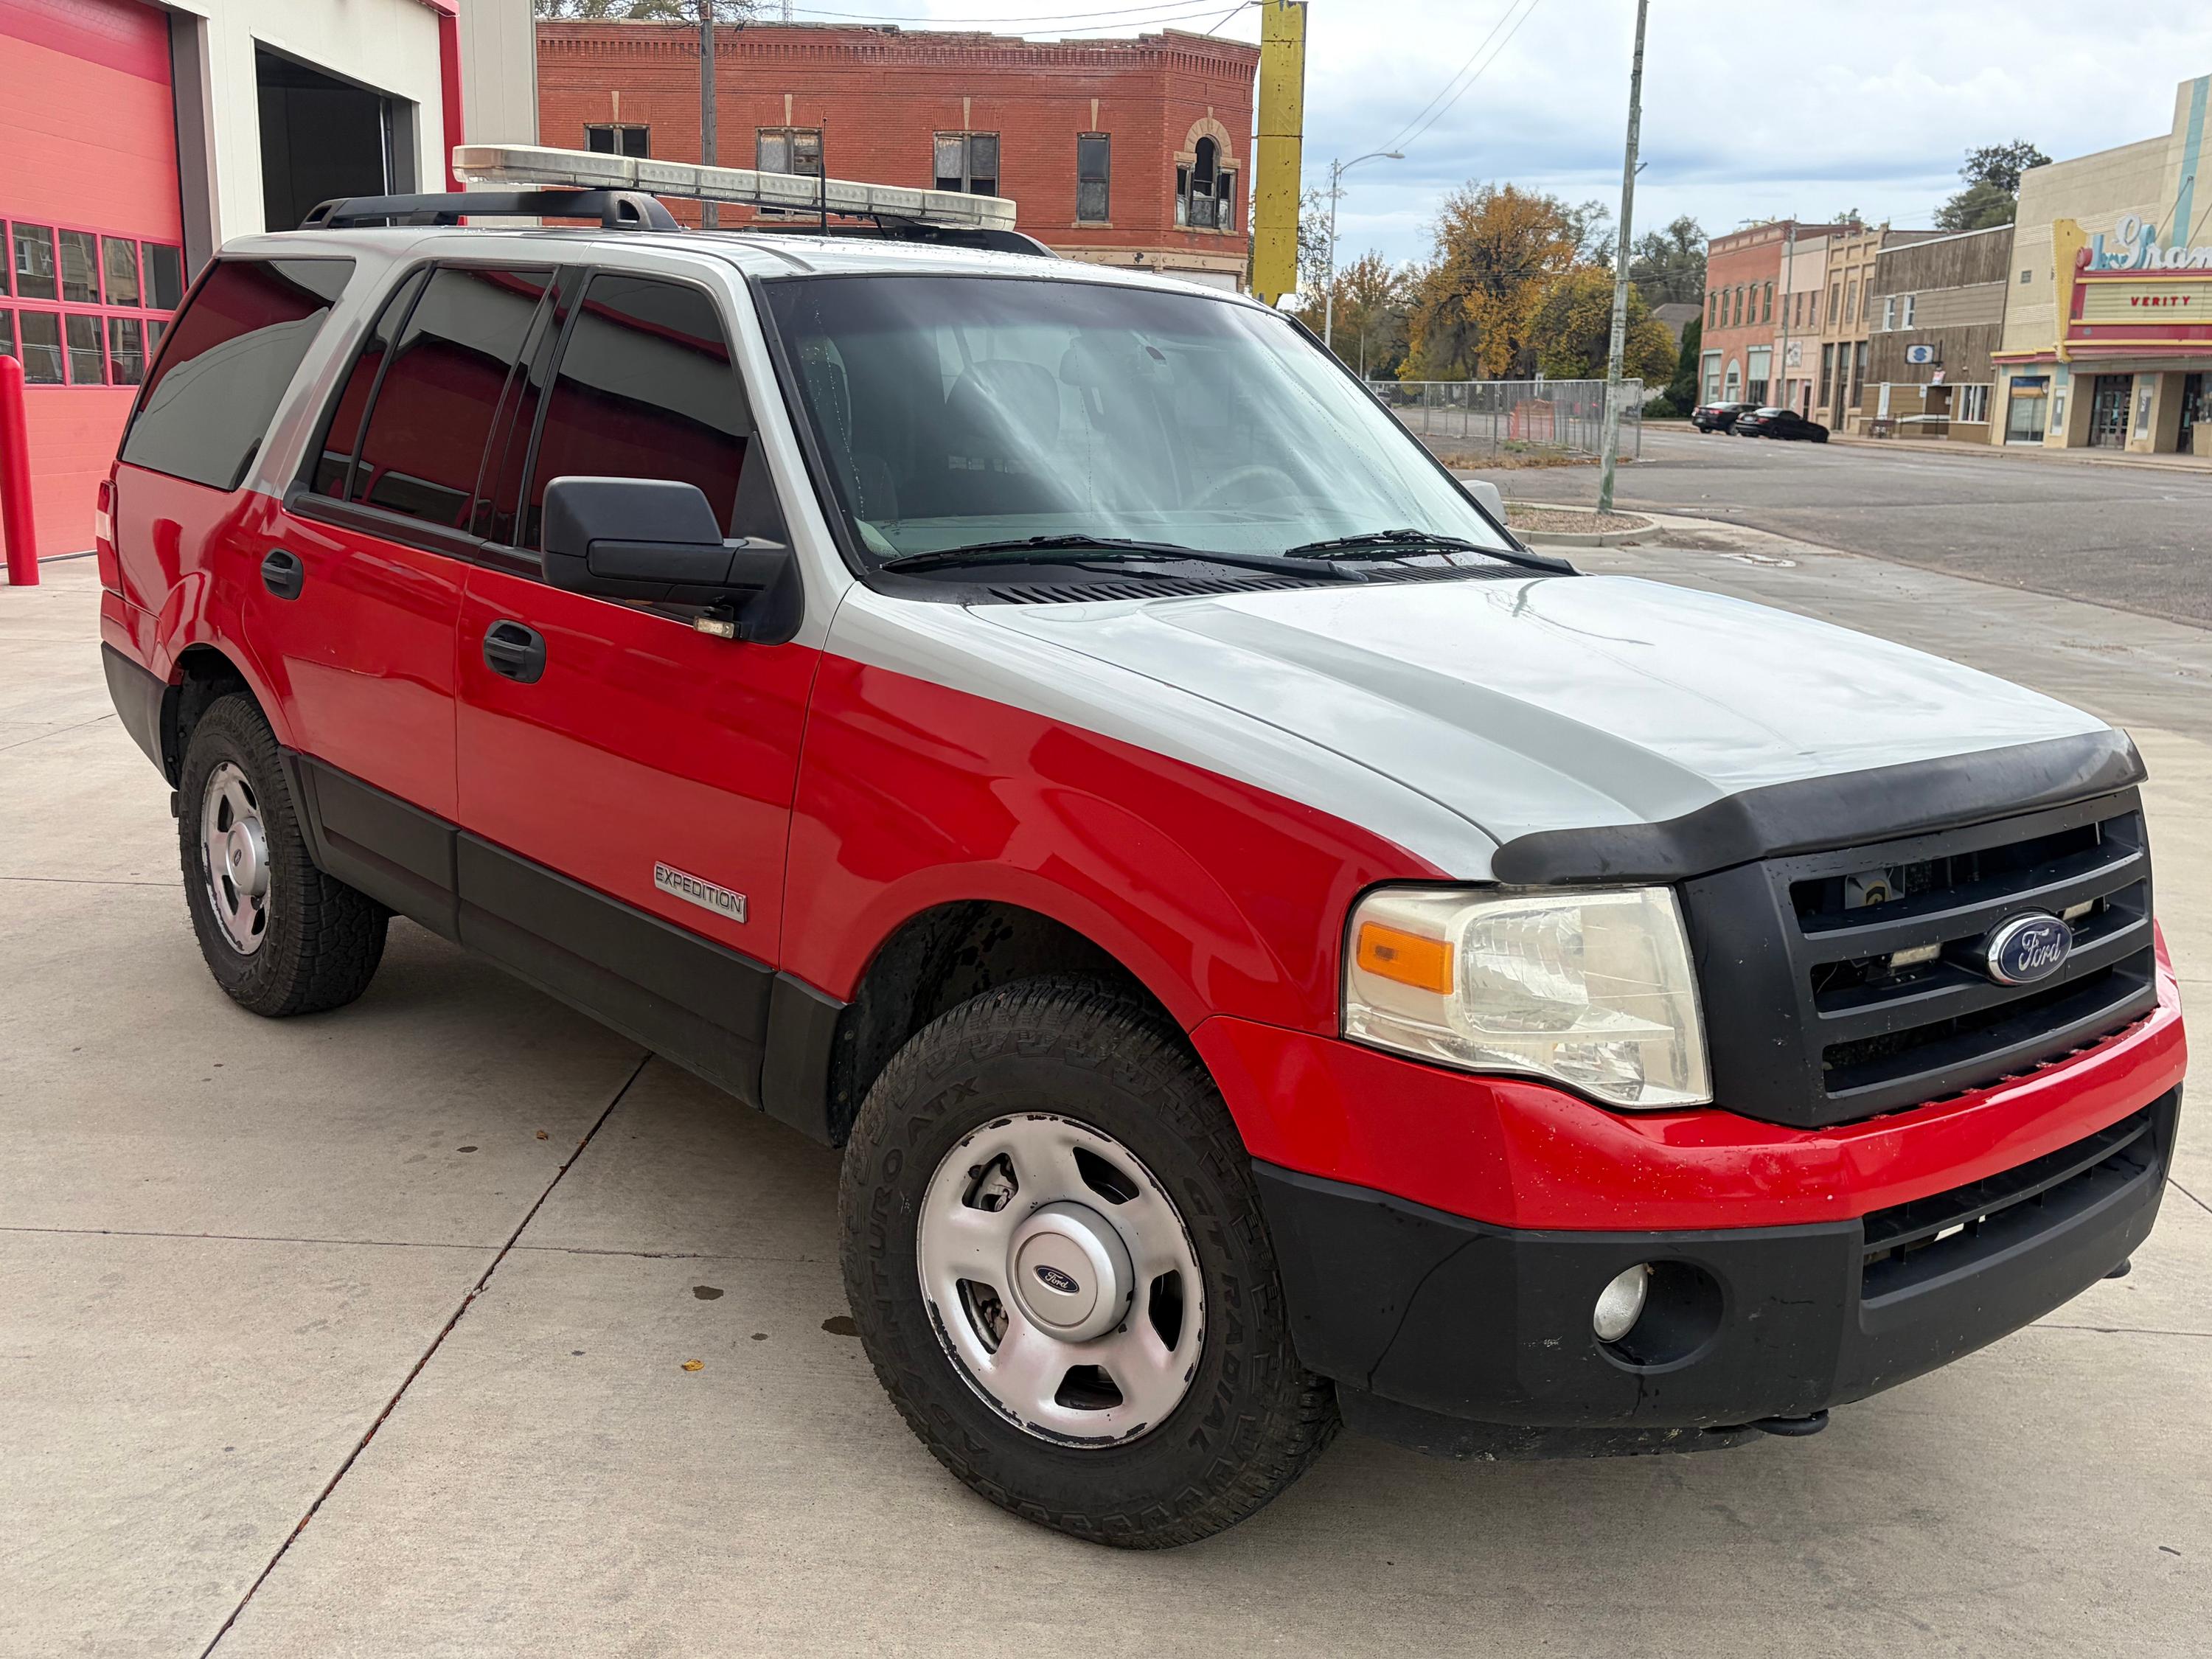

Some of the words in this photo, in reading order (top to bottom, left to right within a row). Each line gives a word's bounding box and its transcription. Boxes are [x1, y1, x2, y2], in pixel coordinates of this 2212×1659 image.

[2130, 296, 2191, 306] VERITY
[655, 866, 742, 914] EXPEDITION
[2019, 928, 2062, 971] Ford
[906, 1075, 980, 1147] ATX
[1045, 1271, 1068, 1288] Ford
